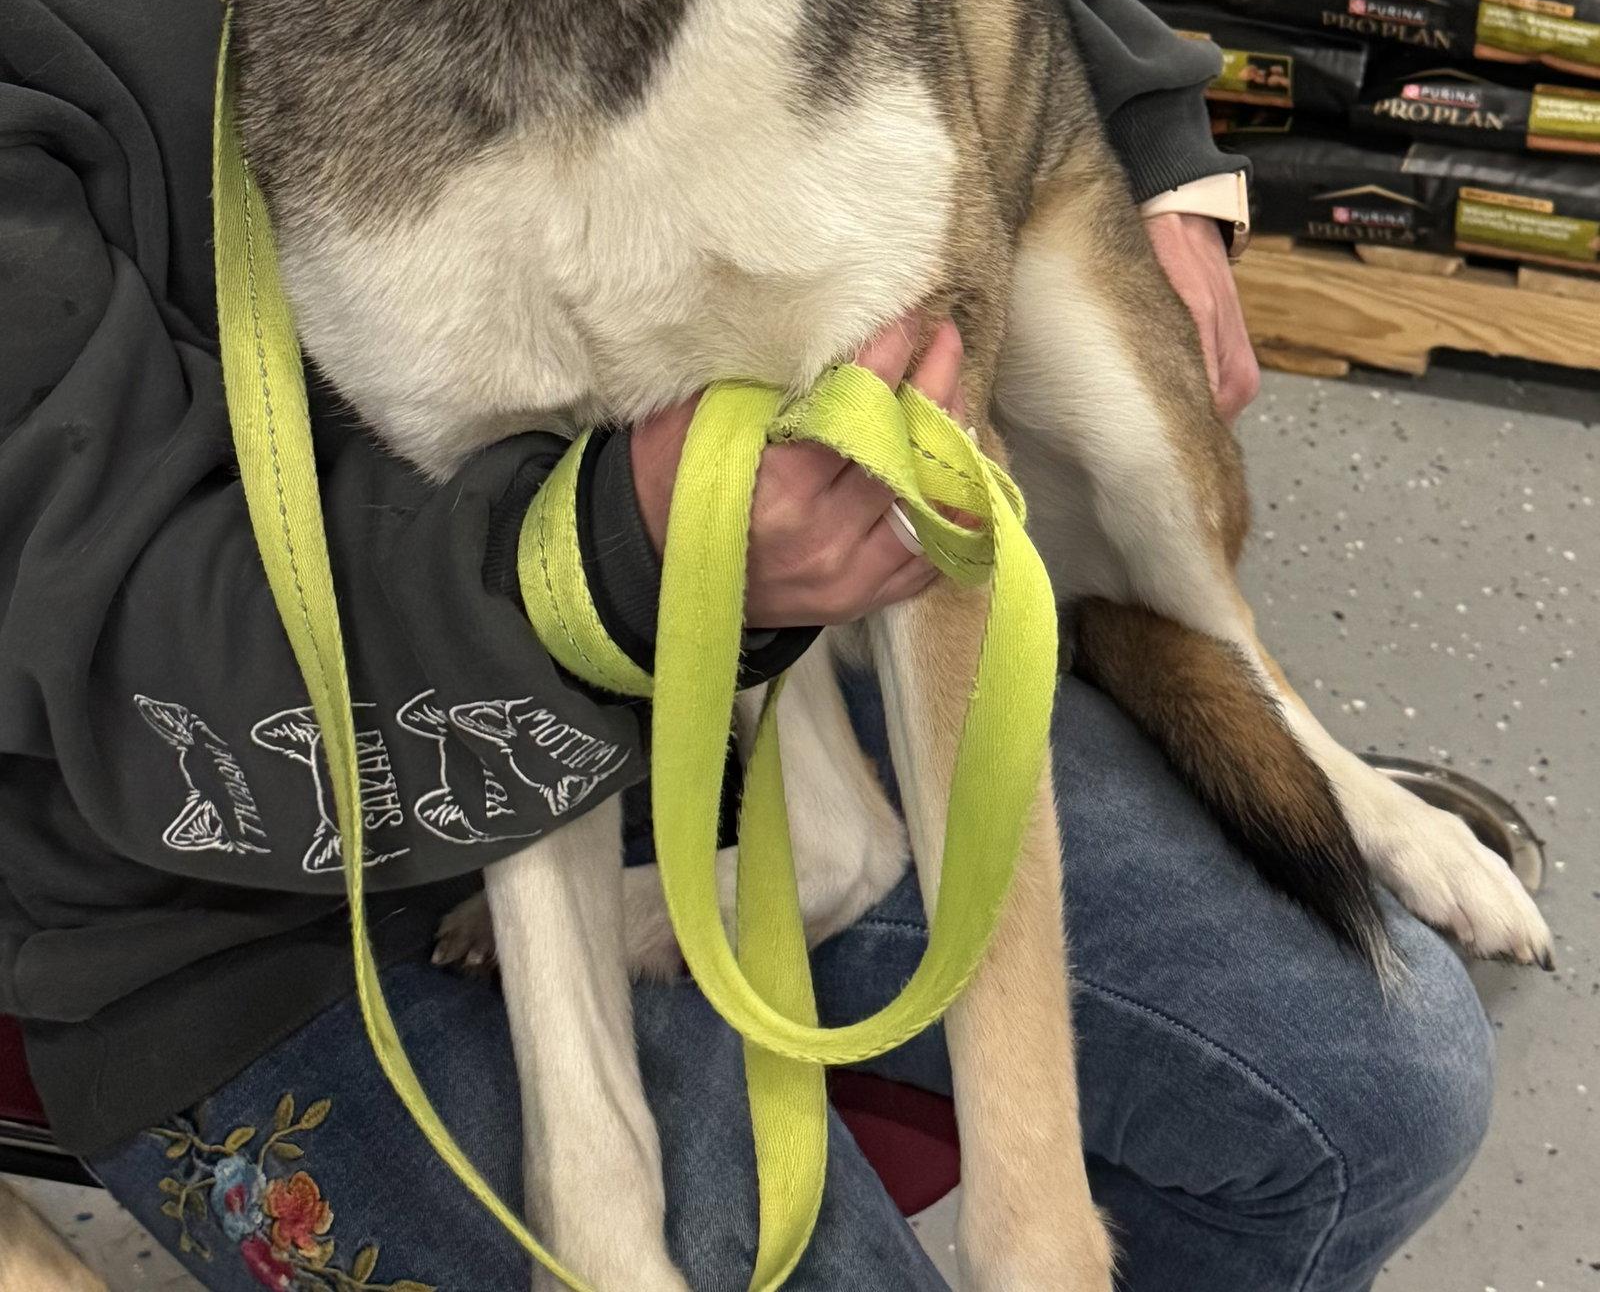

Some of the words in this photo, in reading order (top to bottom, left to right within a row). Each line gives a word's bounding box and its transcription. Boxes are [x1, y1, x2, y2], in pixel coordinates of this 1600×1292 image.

[1367, 2, 1424, 21] PURINA
[1422, 86, 1476, 102] PURINA
[1351, 210, 1406, 226] PURINA
[516, 709, 619, 772] WILLOW
